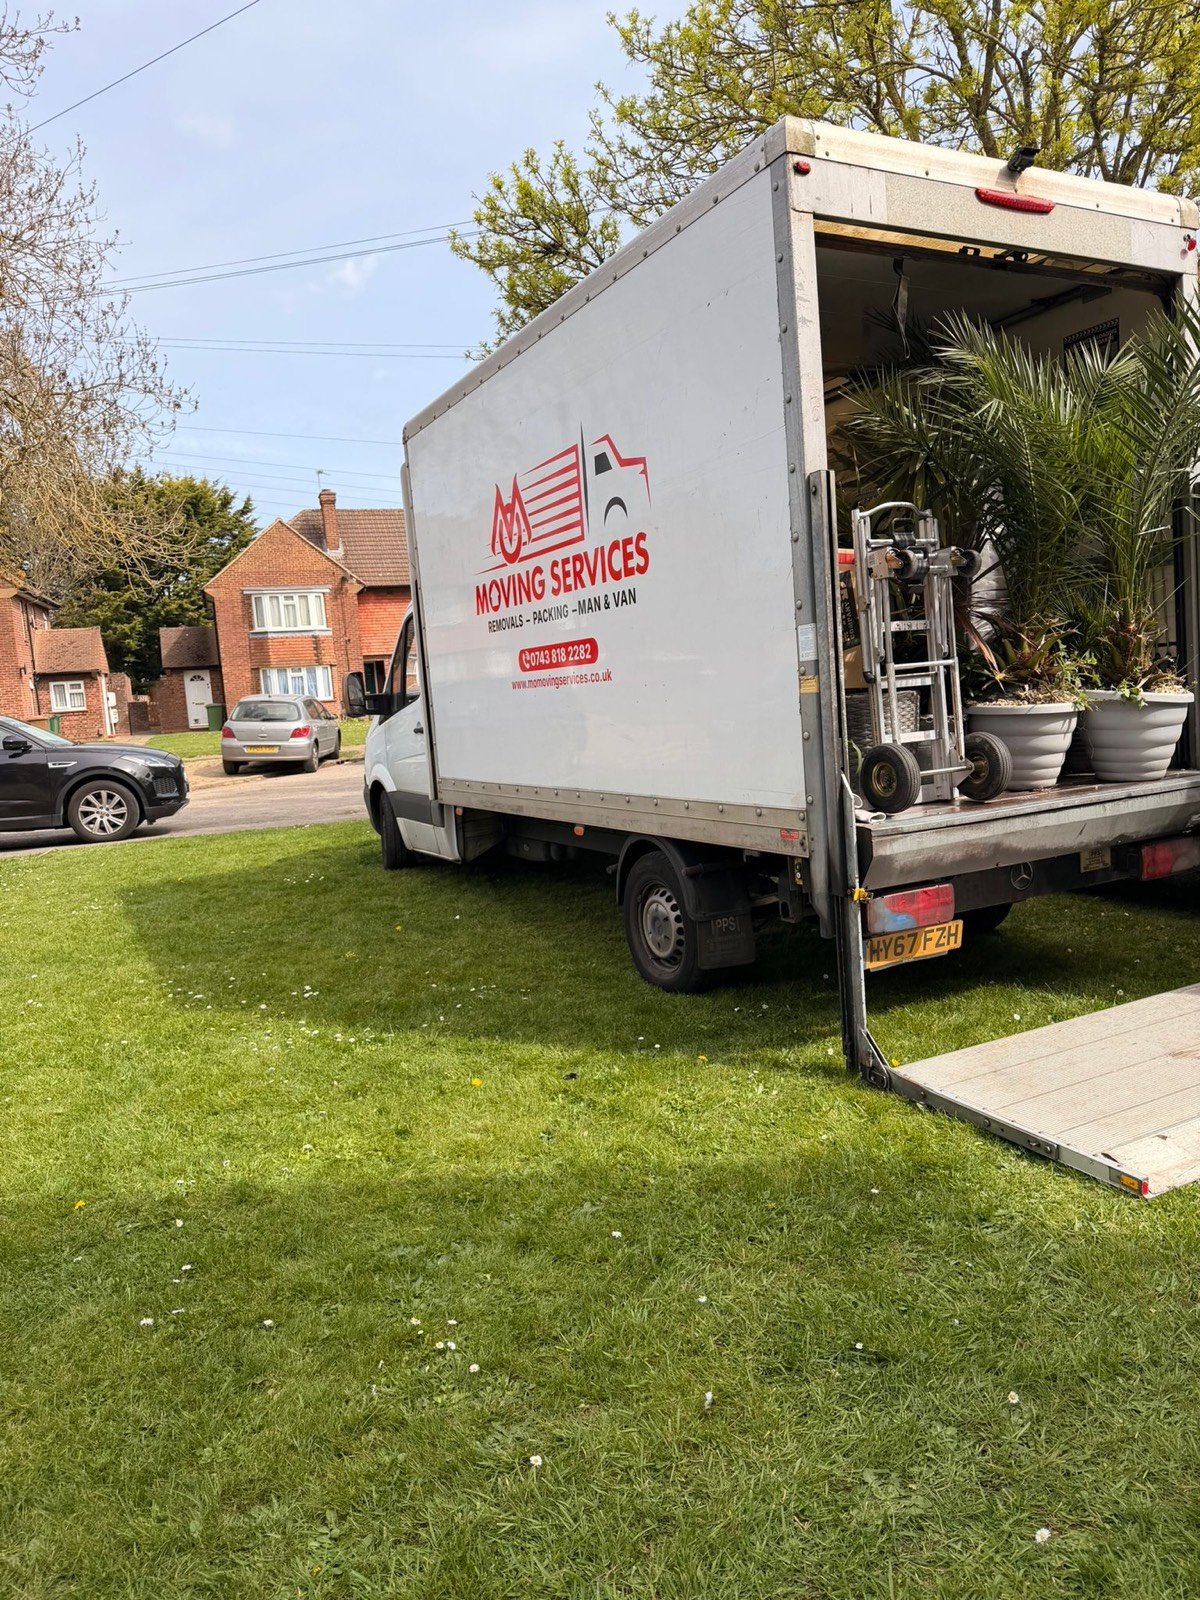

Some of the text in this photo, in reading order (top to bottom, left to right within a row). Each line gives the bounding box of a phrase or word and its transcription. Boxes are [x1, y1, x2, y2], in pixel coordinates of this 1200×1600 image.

[475, 532, 650, 616] MOVING SERVICES
[488, 614, 524, 634] REMOVALS
[532, 604, 570, 625] PACKING
[604, 594, 612, 610] &
[613, 588, 637, 606] VAN
[530, 643, 592, 667] 0743 818 2282
[511, 669, 612, 690] www.momovingservices.co.uk
[869, 924, 960, 963] HY67 FZH
